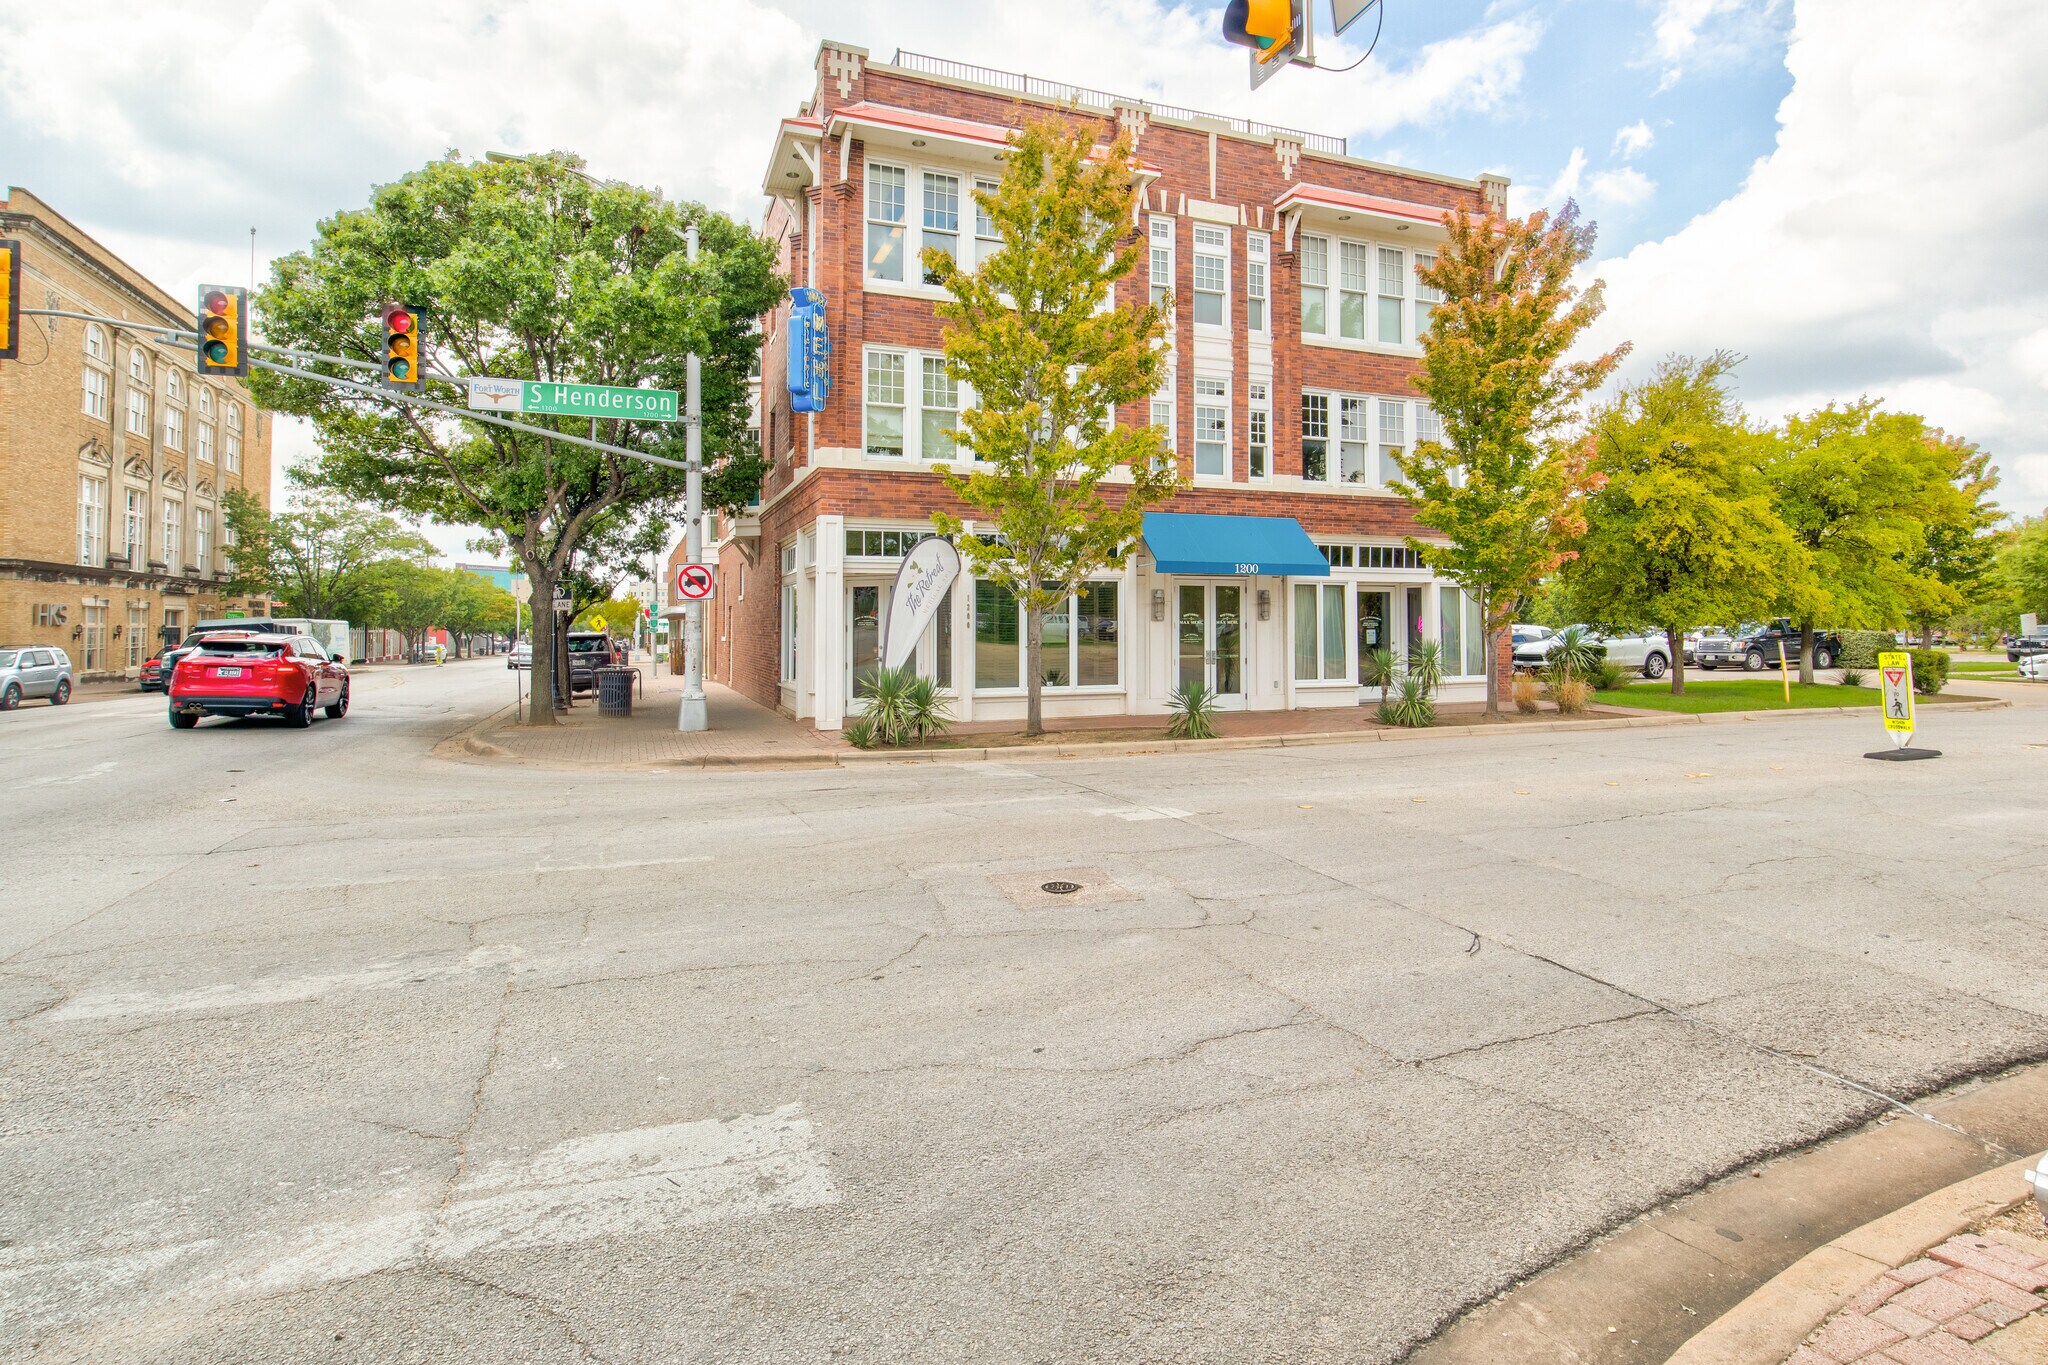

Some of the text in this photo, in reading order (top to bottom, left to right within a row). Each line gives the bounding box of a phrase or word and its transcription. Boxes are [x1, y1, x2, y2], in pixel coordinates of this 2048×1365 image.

[813, 313, 825, 401] MEHL
[493, 384, 520, 394] WORTH
[531, 384, 670, 411] S Henderson
[1235, 563, 1259, 574] 1200
[905, 553, 944, 616] The Retreat
[37, 603, 68, 626] HKS
